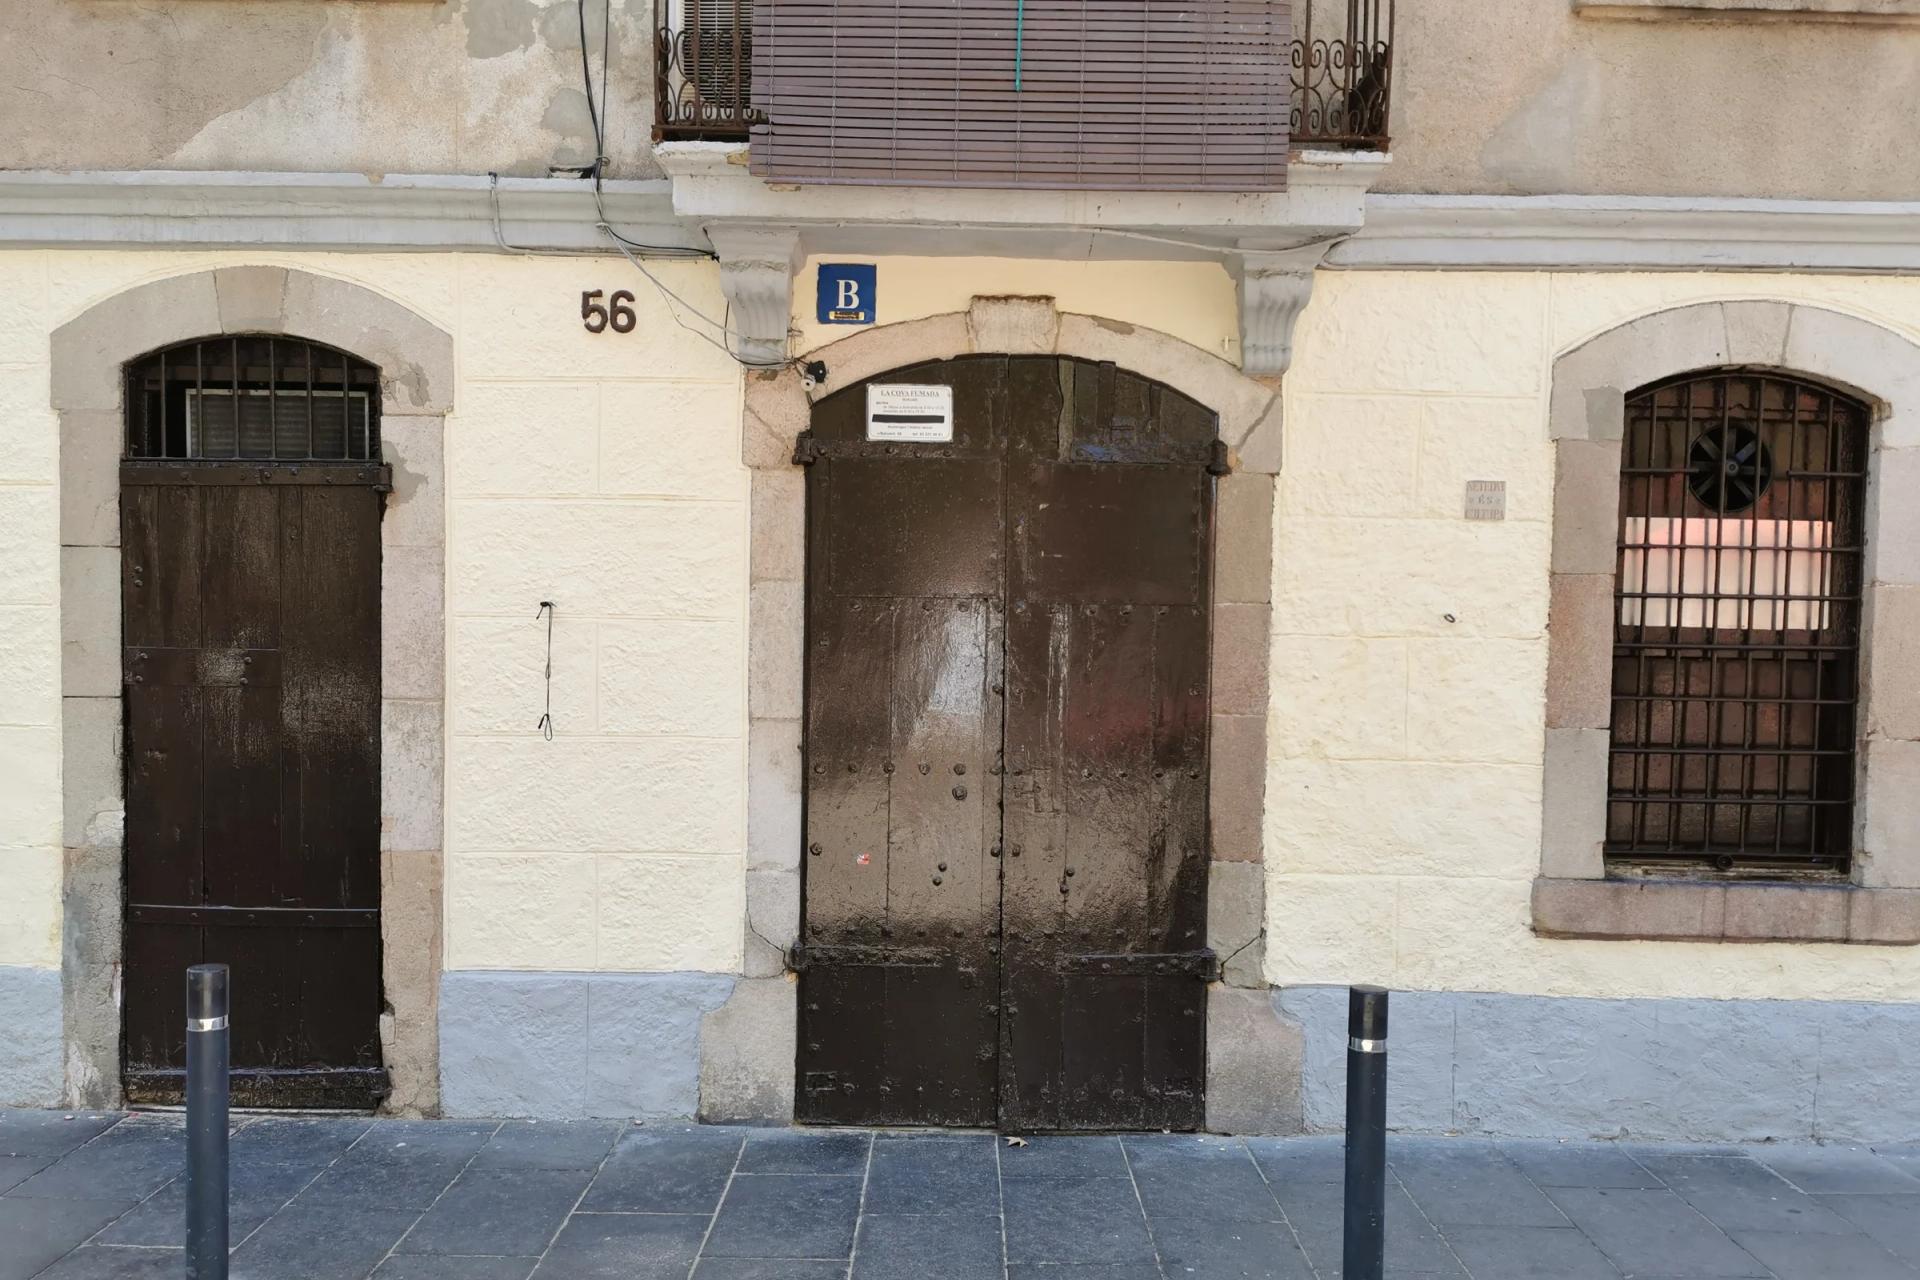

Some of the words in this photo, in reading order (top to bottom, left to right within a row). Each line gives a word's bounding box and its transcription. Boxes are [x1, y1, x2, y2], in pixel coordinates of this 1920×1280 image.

[836, 279, 860, 309] B
[581, 289, 637, 334] 56
[880, 389, 891, 397] LA
[891, 389, 910, 398] COVA
[910, 390, 940, 398] FUMADA
